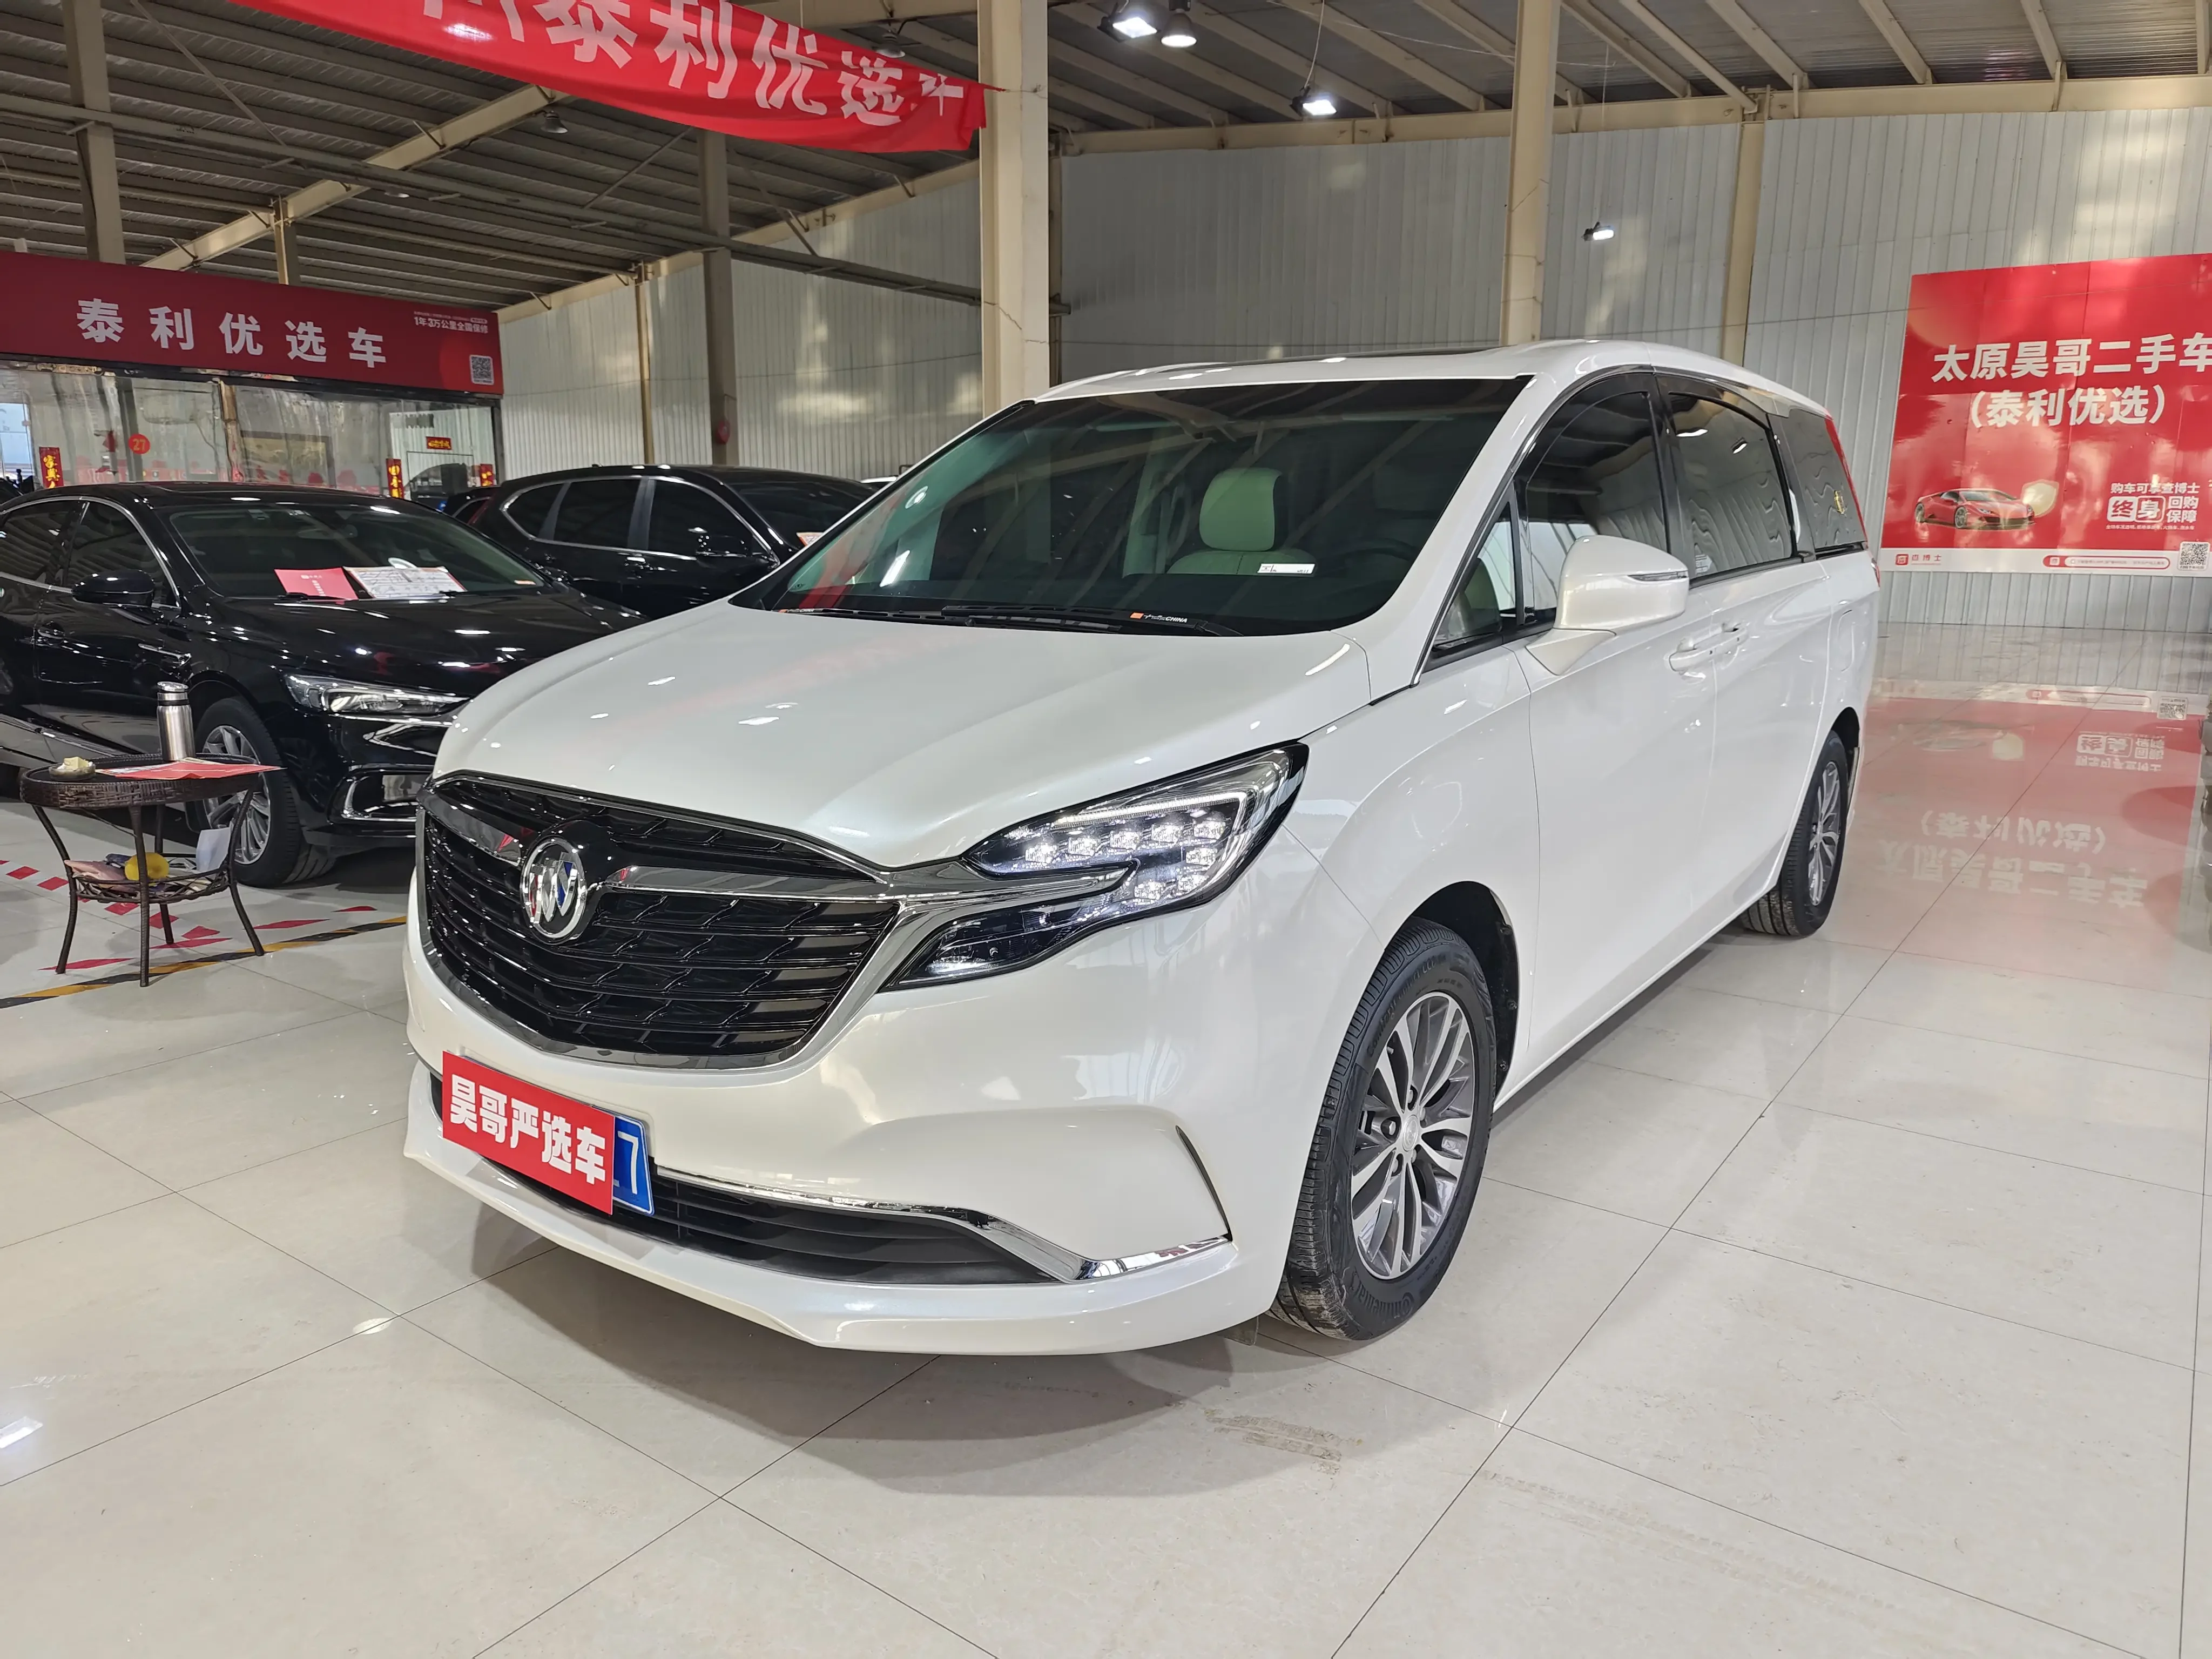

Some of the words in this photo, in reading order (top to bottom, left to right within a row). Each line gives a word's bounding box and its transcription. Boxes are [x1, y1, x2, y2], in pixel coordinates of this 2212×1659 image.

[423, 0, 963, 126] 泰利优选
[77, 298, 387, 369] 泰利优选车
[1931, 332, 2212, 383] 太原昊哥二手车
[1971, 384, 2166, 428] (泰利优选)
[132, 438, 146, 451] 27
[2110, 500, 2161, 520] 终身
[2166, 510, 2197, 523] 保障
[2168, 496, 2199, 509] 回购
[450, 1074, 606, 1185] 昊哥严选车
